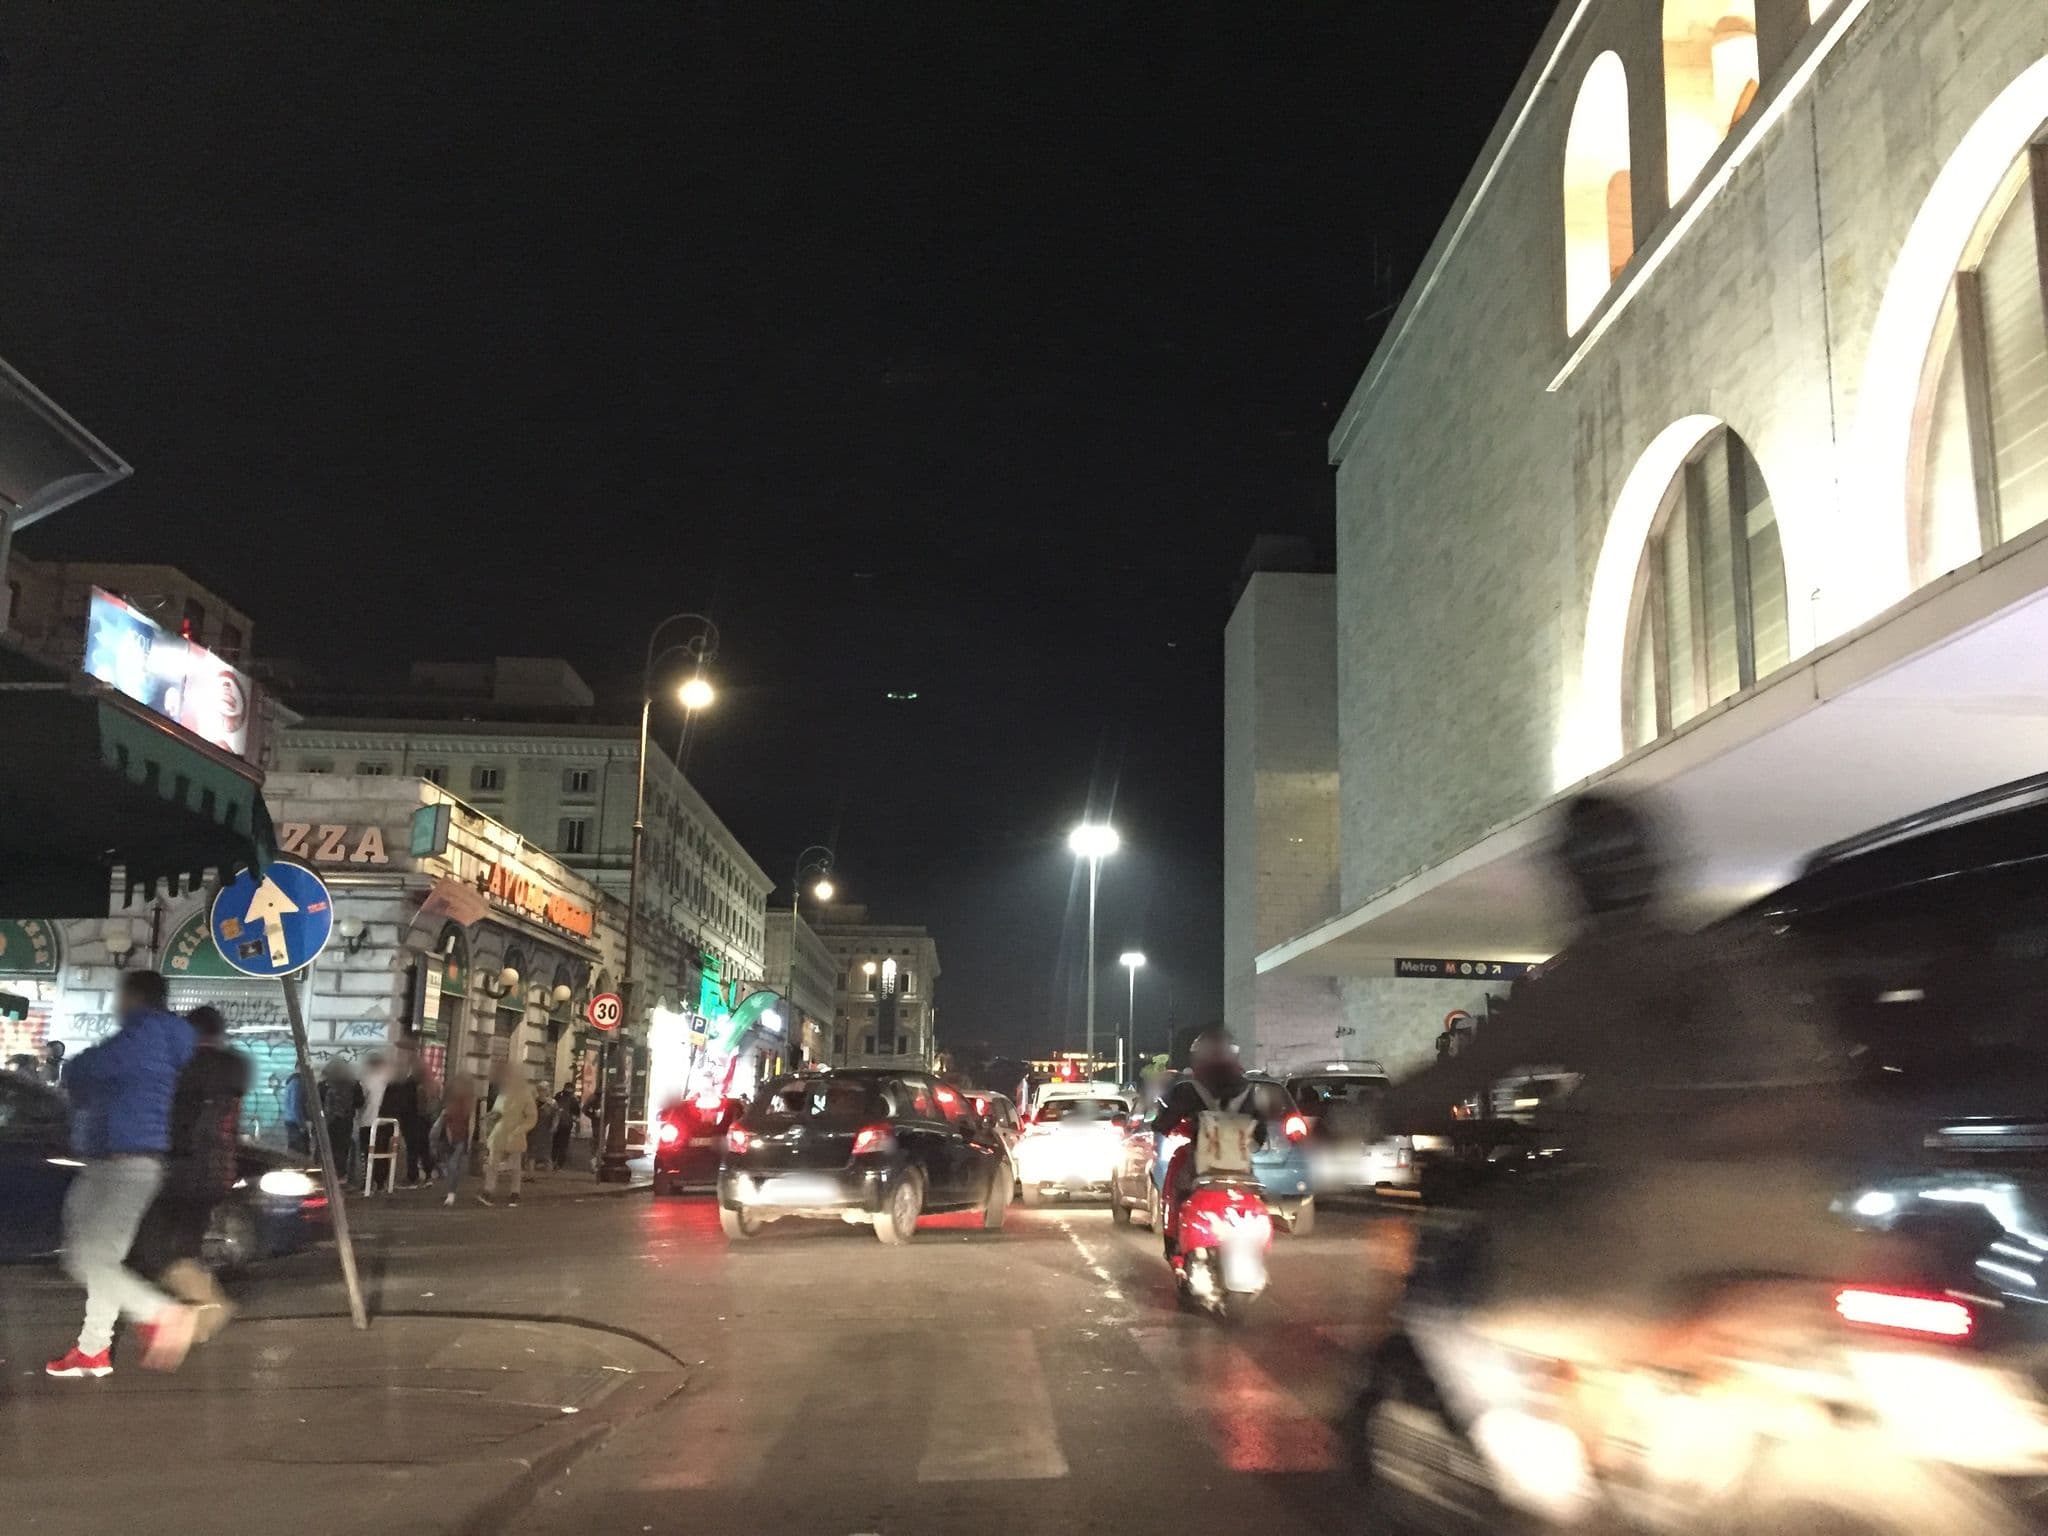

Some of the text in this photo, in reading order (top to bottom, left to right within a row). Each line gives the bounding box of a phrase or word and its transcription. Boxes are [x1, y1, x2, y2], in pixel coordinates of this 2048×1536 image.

[282, 823, 389, 864] ZZA
[1400, 960, 1438, 973] Metro
[597, 1003, 617, 1020] 30
[694, 1018, 704, 1031] P
